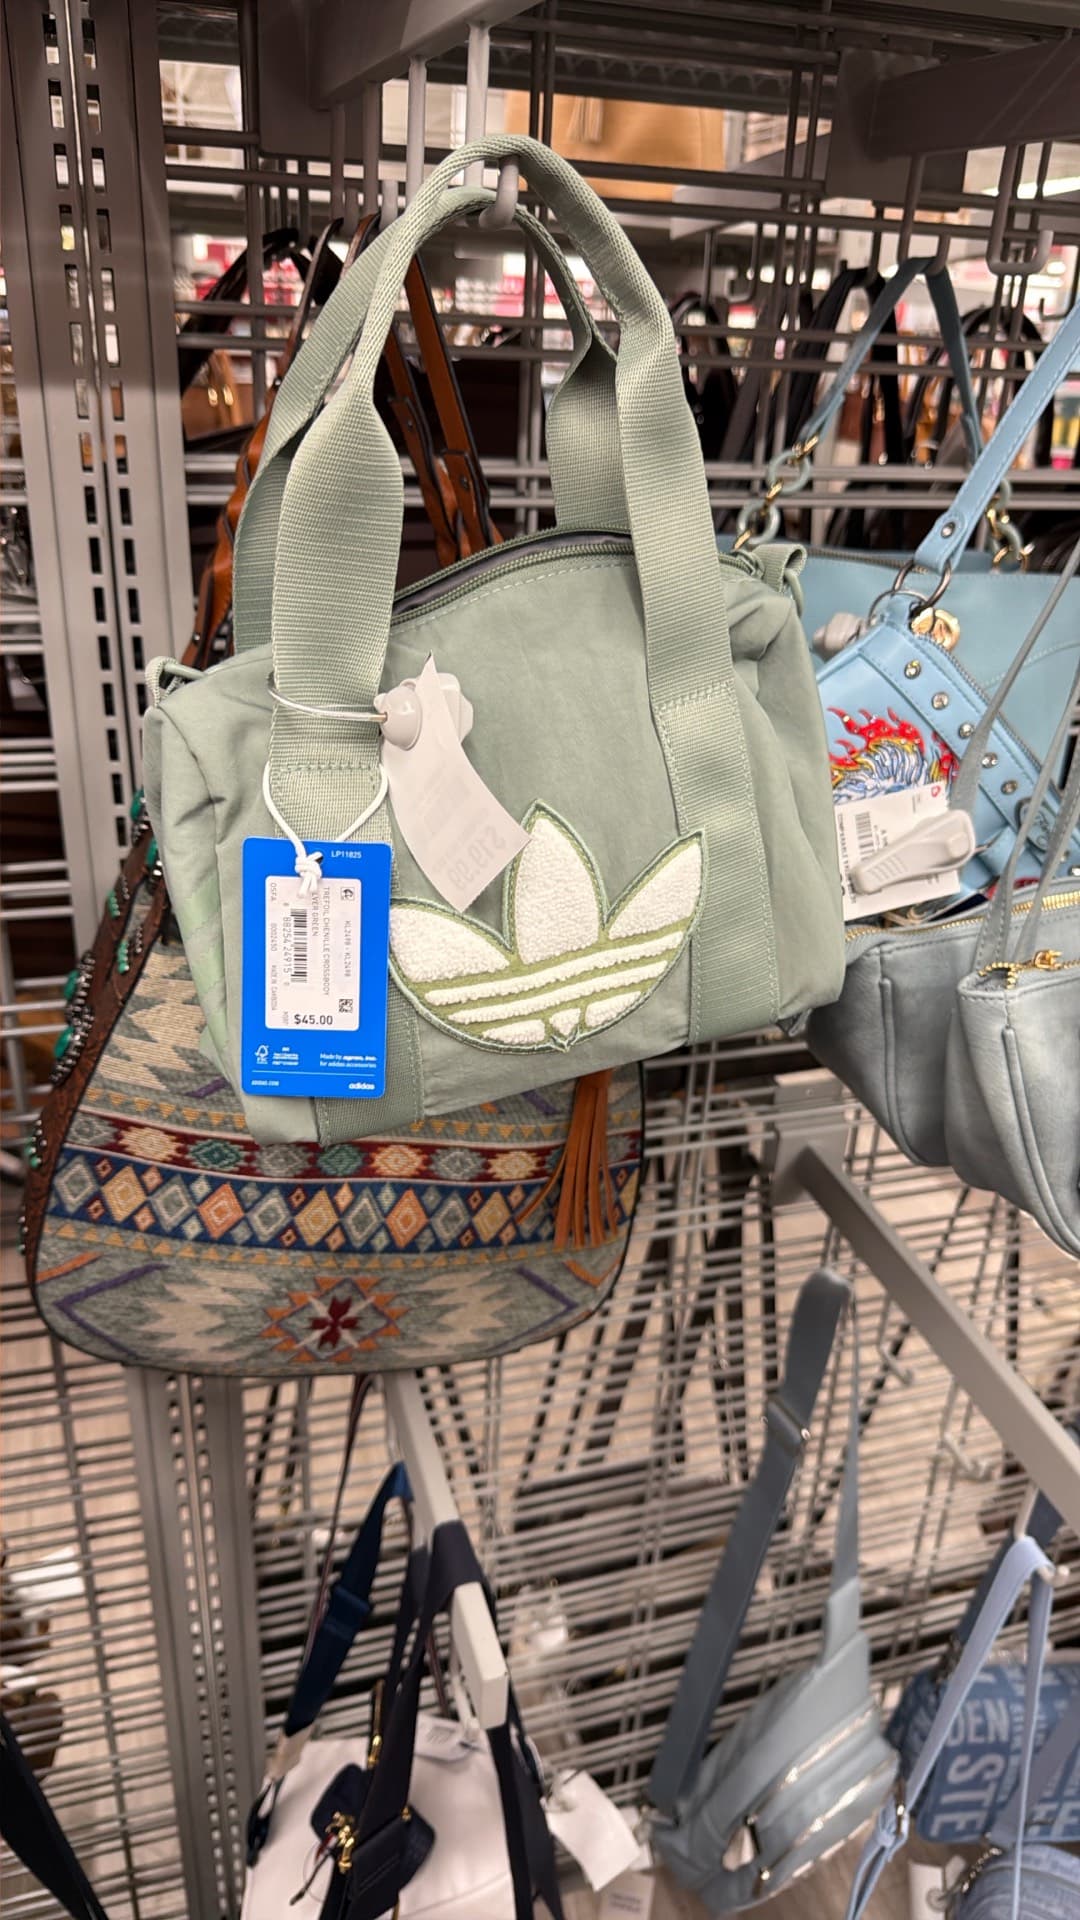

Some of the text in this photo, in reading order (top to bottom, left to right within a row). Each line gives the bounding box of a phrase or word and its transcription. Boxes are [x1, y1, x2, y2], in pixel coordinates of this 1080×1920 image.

[283, 917, 291, 944] 88254
[322, 886, 330, 996] TREFOIL CHENILLE CROSSBODY
[283, 945, 291, 974] 24915
[294, 1013, 333, 1026] $45.00
[348, 1082, 376, 1091] adidas
